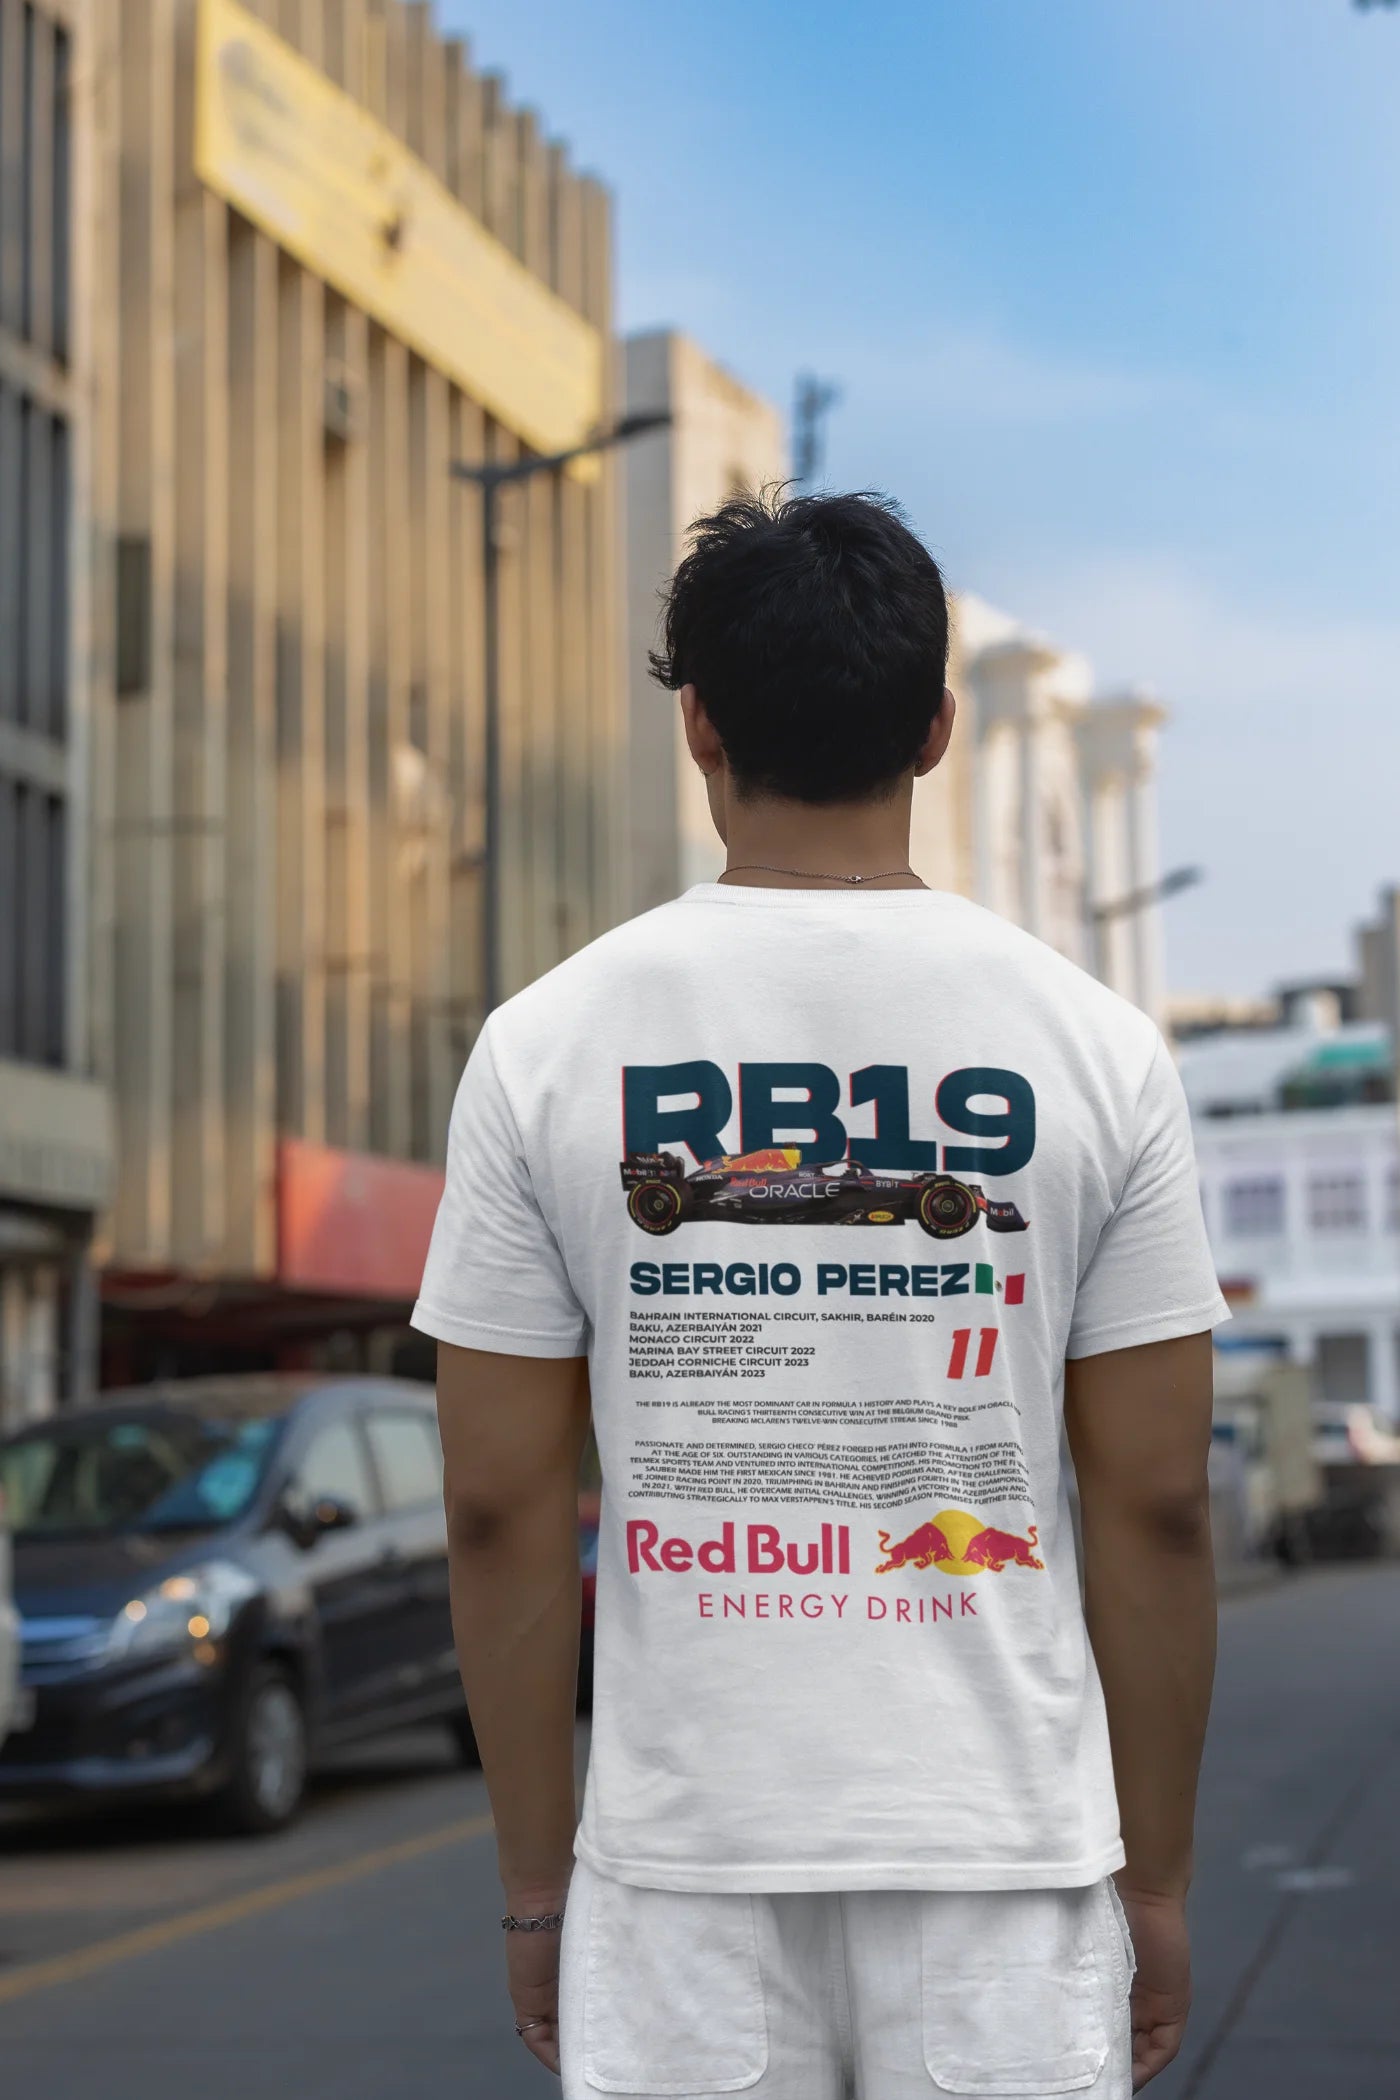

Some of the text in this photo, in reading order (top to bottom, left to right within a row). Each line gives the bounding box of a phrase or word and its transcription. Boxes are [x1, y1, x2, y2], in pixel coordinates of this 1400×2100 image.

[621, 1059, 1036, 1176] RB19
[749, 1182, 840, 1198] ORACLE
[990, 1207, 1014, 1217] Mobil
[629, 1262, 970, 1297] SERGIO PEREZ
[630, 1311, 935, 1322] BAHRAIN INTERNATIONAL CIRCUIT, SAKHIR, BARÉIN 2020
[629, 1322, 762, 1333] BAKU, AZERBAIYÁN 2021
[629, 1334, 755, 1344] MONACO CIRCUIT 2022
[629, 1346, 816, 1355] MARINA BAY STREET CIRCUIT 2022
[946, 1327, 999, 1380] 11
[628, 1358, 809, 1367] JEDDAH CORNICHE CIRCUIT 2023
[629, 1368, 766, 1379] BAKU, AZERBAIYÁN 2023
[913, 1399, 934, 1407] PLAYS
[842, 1445, 873, 1453] FORGED
[929, 1442, 968, 1453] FORMULA
[975, 1443, 997, 1451] FROM
[794, 1452, 828, 1460] VARIOUS
[928, 1450, 945, 1458] THE
[945, 1452, 988, 1462] ATTENTION
[661, 1458, 691, 1466] SPORTS
[797, 1461, 859, 1471] INTERNATIONAL
[932, 1459, 980, 1470] PROMOTION
[993, 1459, 1007, 1467] THE
[794, 1469, 816, 1477] SINCE
[852, 1473, 890, 1481] ACHIEVED
[645, 1474, 675, 1482] JOINED
[676, 1476, 707, 1485] RACING
[765, 1478, 813, 1486] TRIUMPHING
[824, 1481, 860, 1490] BAHRAIN
[880, 1477, 916, 1490] FINISHING
[917, 1475, 949, 1483] FOURTH
[962, 1480, 976, 1488] THE
[794, 1487, 821, 1495] INITIAL
[876, 1488, 909, 1500] WINNING
[628, 1491, 685, 1500] CONTRIBUTING
[686, 1494, 748, 1503] STRATEGICALLY
[873, 1499, 903, 1509] SECOND
[904, 1492, 932, 1505] SEASON
[934, 1492, 972, 1504] PROMISES
[974, 1494, 1007, 1505] FURTHER
[625, 1519, 850, 1575] Red Bull
[698, 1591, 978, 1623] ENERGY DRINK
